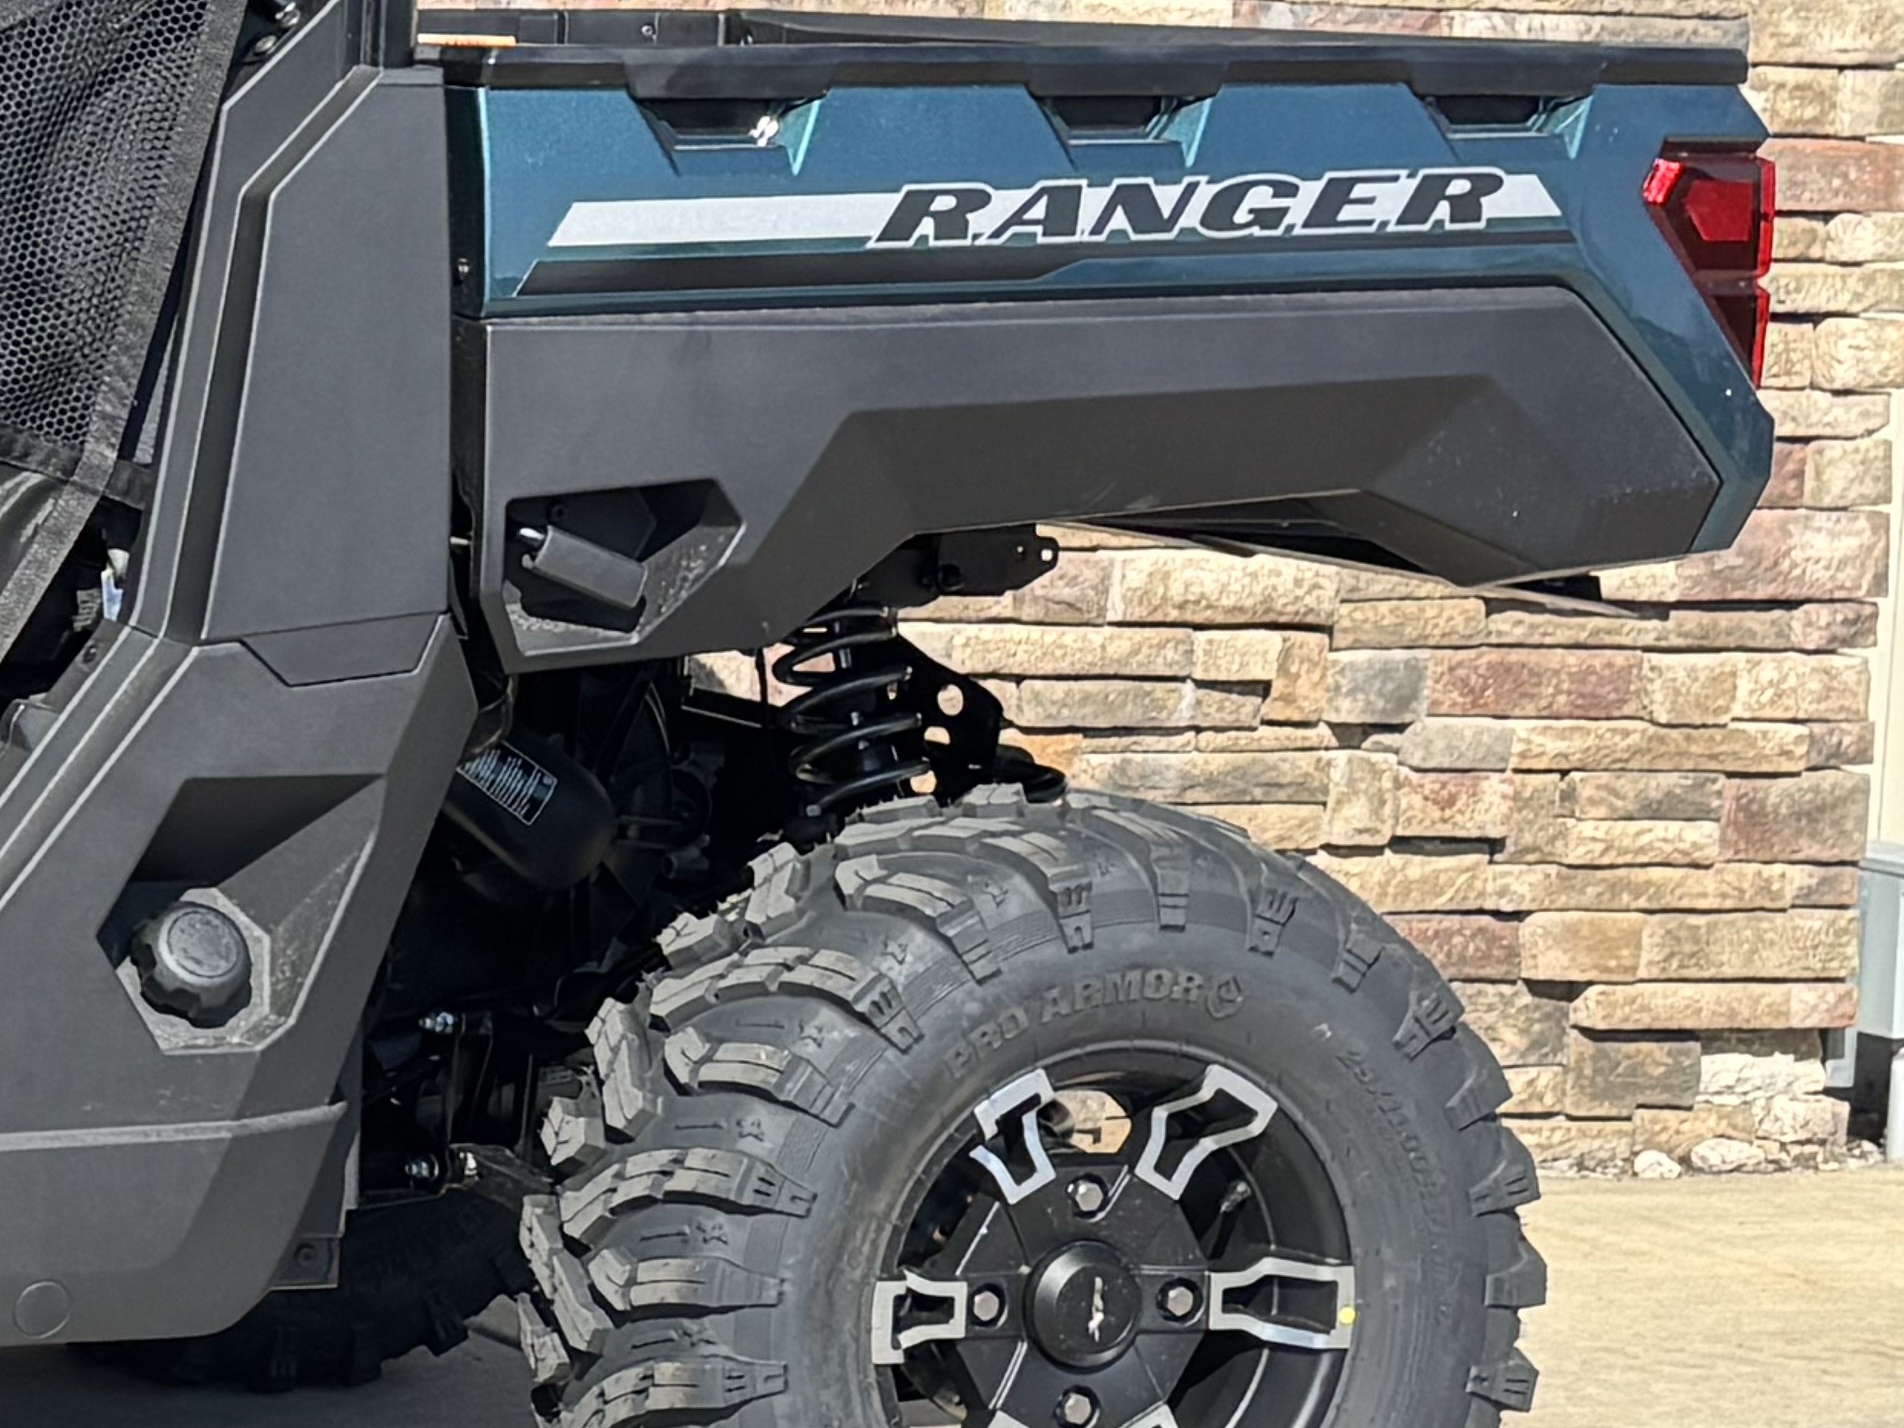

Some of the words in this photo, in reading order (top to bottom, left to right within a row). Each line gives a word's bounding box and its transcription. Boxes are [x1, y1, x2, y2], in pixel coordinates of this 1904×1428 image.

[866, 168, 1504, 250] RANGER
[942, 1006, 1030, 1080] PRO
[1040, 967, 1204, 1023] ARMOR
